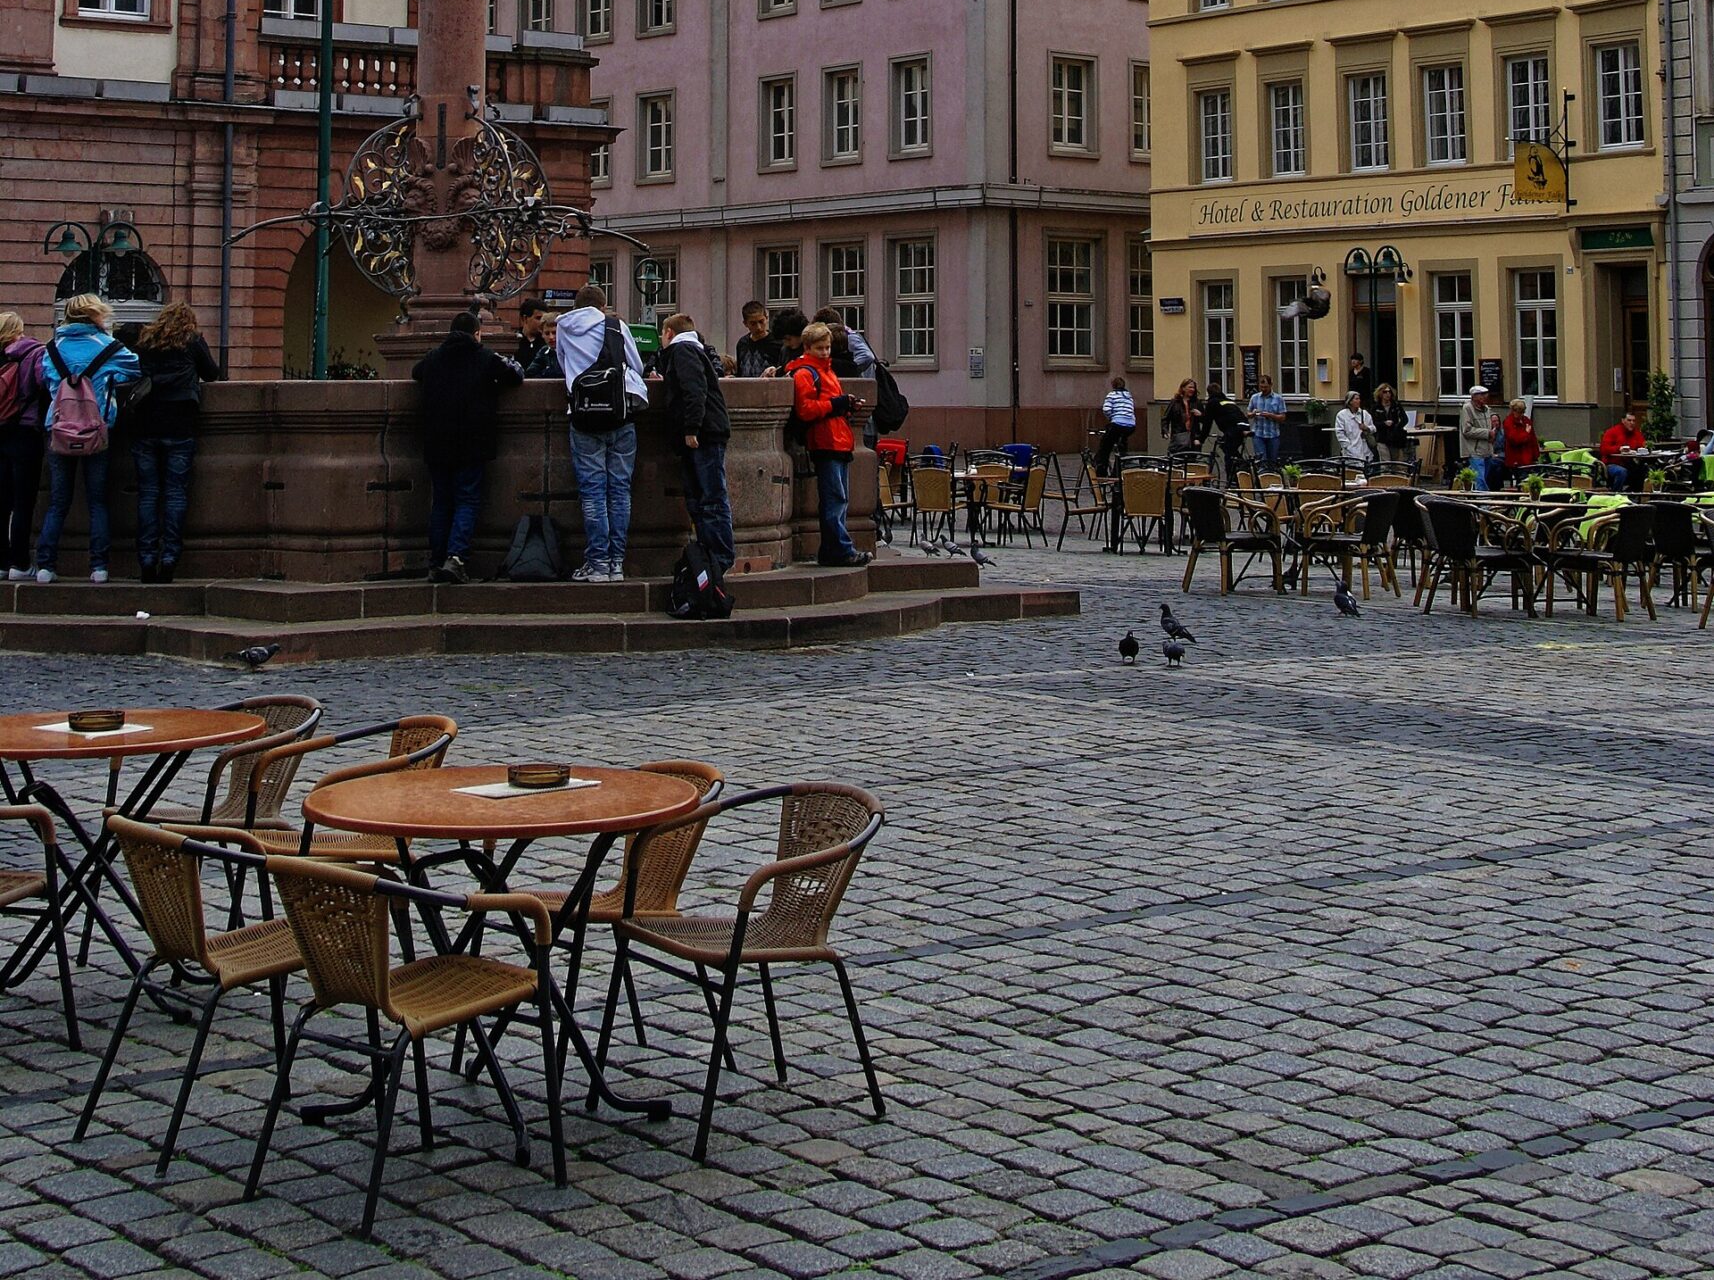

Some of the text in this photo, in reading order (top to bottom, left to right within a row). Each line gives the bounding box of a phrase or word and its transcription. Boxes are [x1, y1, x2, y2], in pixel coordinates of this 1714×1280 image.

[1198, 198, 1248, 225] Hotel
[1251, 200, 1264, 222] &
[1269, 192, 1394, 221] Restauration
[1400, 184, 1490, 217] Goldener
